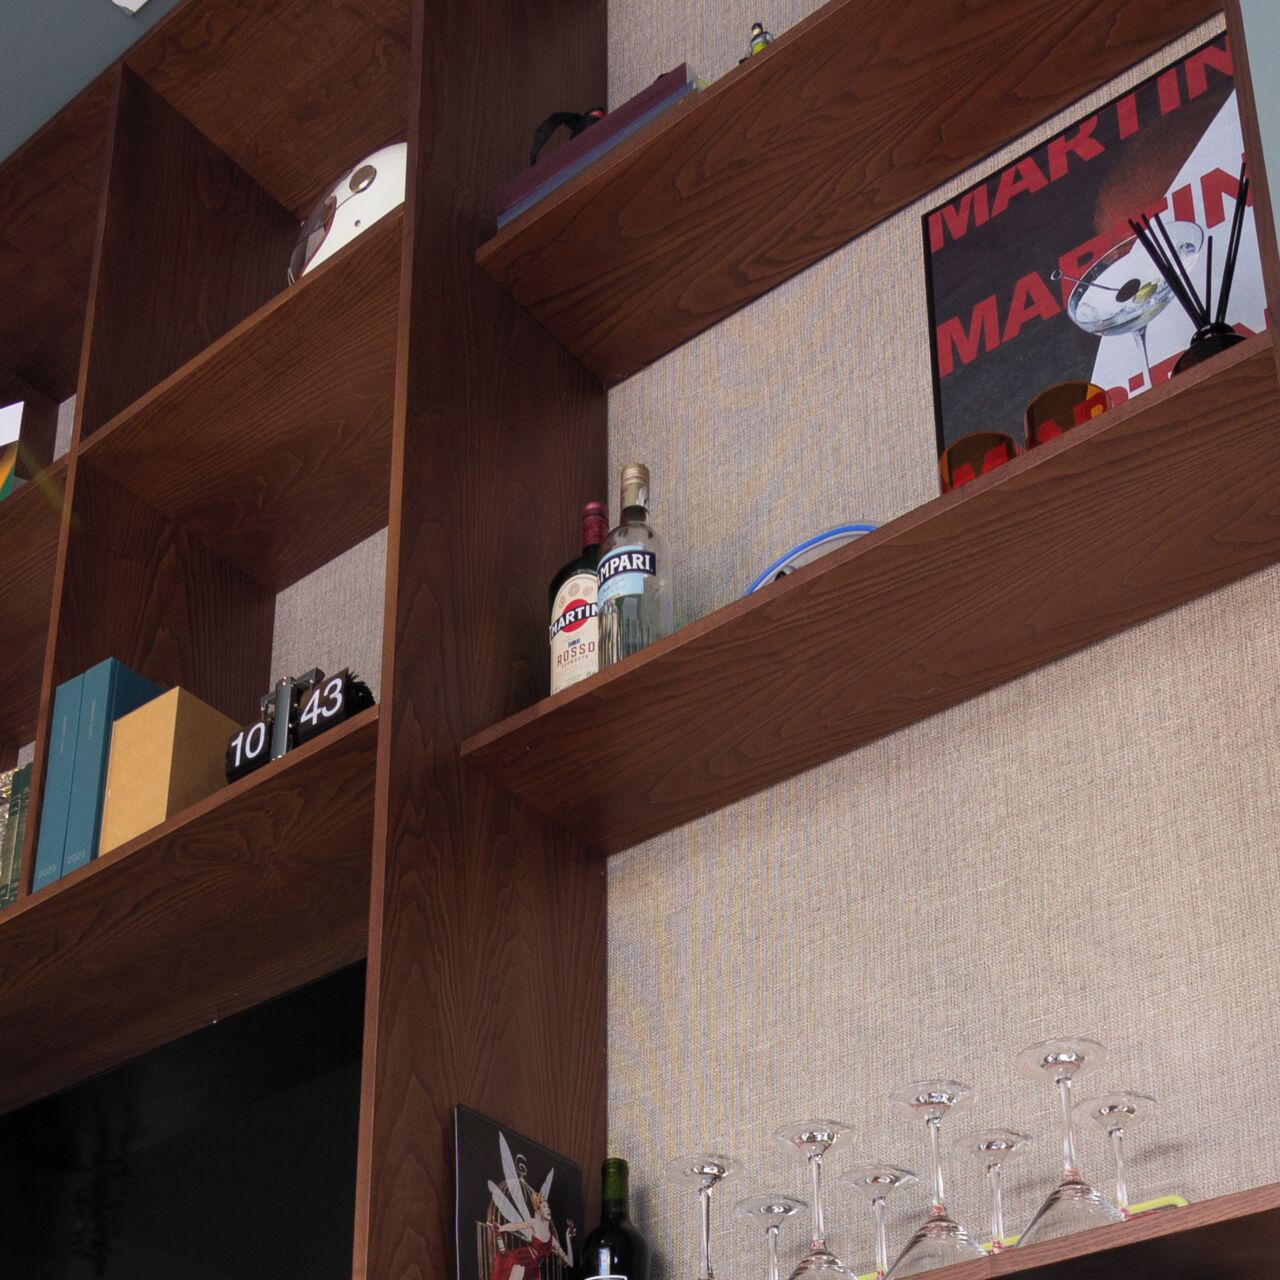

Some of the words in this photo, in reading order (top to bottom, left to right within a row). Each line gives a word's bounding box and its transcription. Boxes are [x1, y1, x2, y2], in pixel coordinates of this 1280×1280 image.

[598, 553, 651, 585] MPARI
[556, 641, 595, 666] ROSSO
[300, 677, 343, 726] 43
[231, 722, 266, 768] 10
